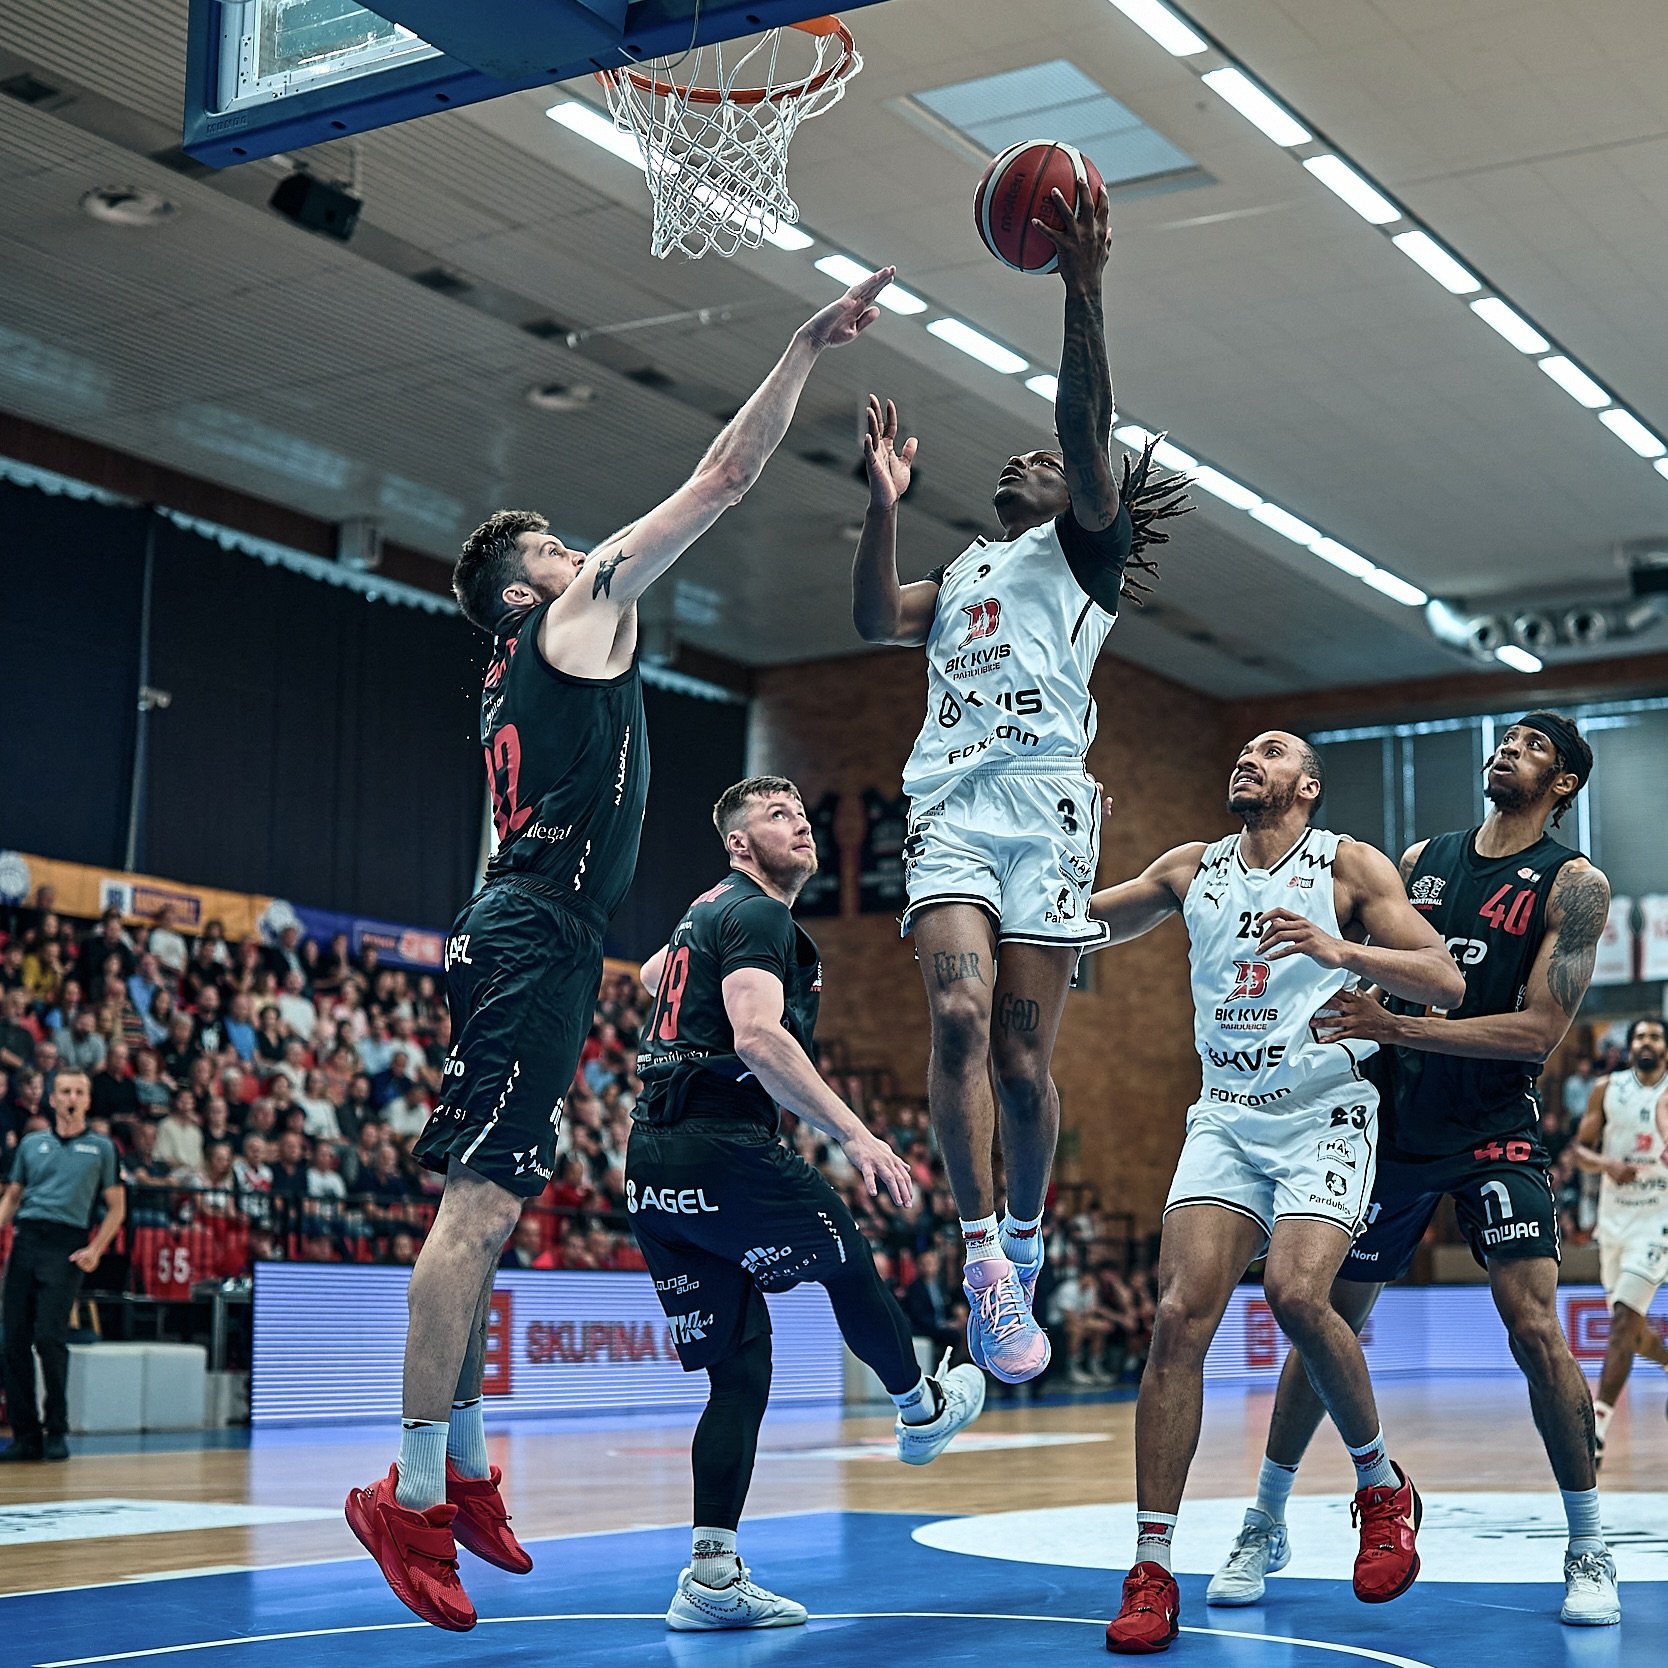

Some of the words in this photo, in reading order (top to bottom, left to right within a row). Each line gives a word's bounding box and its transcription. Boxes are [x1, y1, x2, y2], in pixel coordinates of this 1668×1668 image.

[944, 654, 968, 675] BK
[971, 643, 1011, 667] KVIS
[1479, 883, 1537, 936] 40
[1236, 911, 1264, 939] 23
[932, 950, 988, 991] FEAR
[646, 945, 690, 1042] 19
[999, 991, 1040, 1040] GOD
[1214, 1007, 1234, 1022] BK
[1237, 1007, 1279, 1022] KVIS
[1220, 1022, 1268, 1031] PARDUBICE
[1330, 1104, 1367, 1130] 23
[1473, 1140, 1532, 1162] 40
[640, 1186, 720, 1214] AGEL
[1350, 1249, 1380, 1262] Nord
[526, 1320, 656, 1364] SKUPINA
